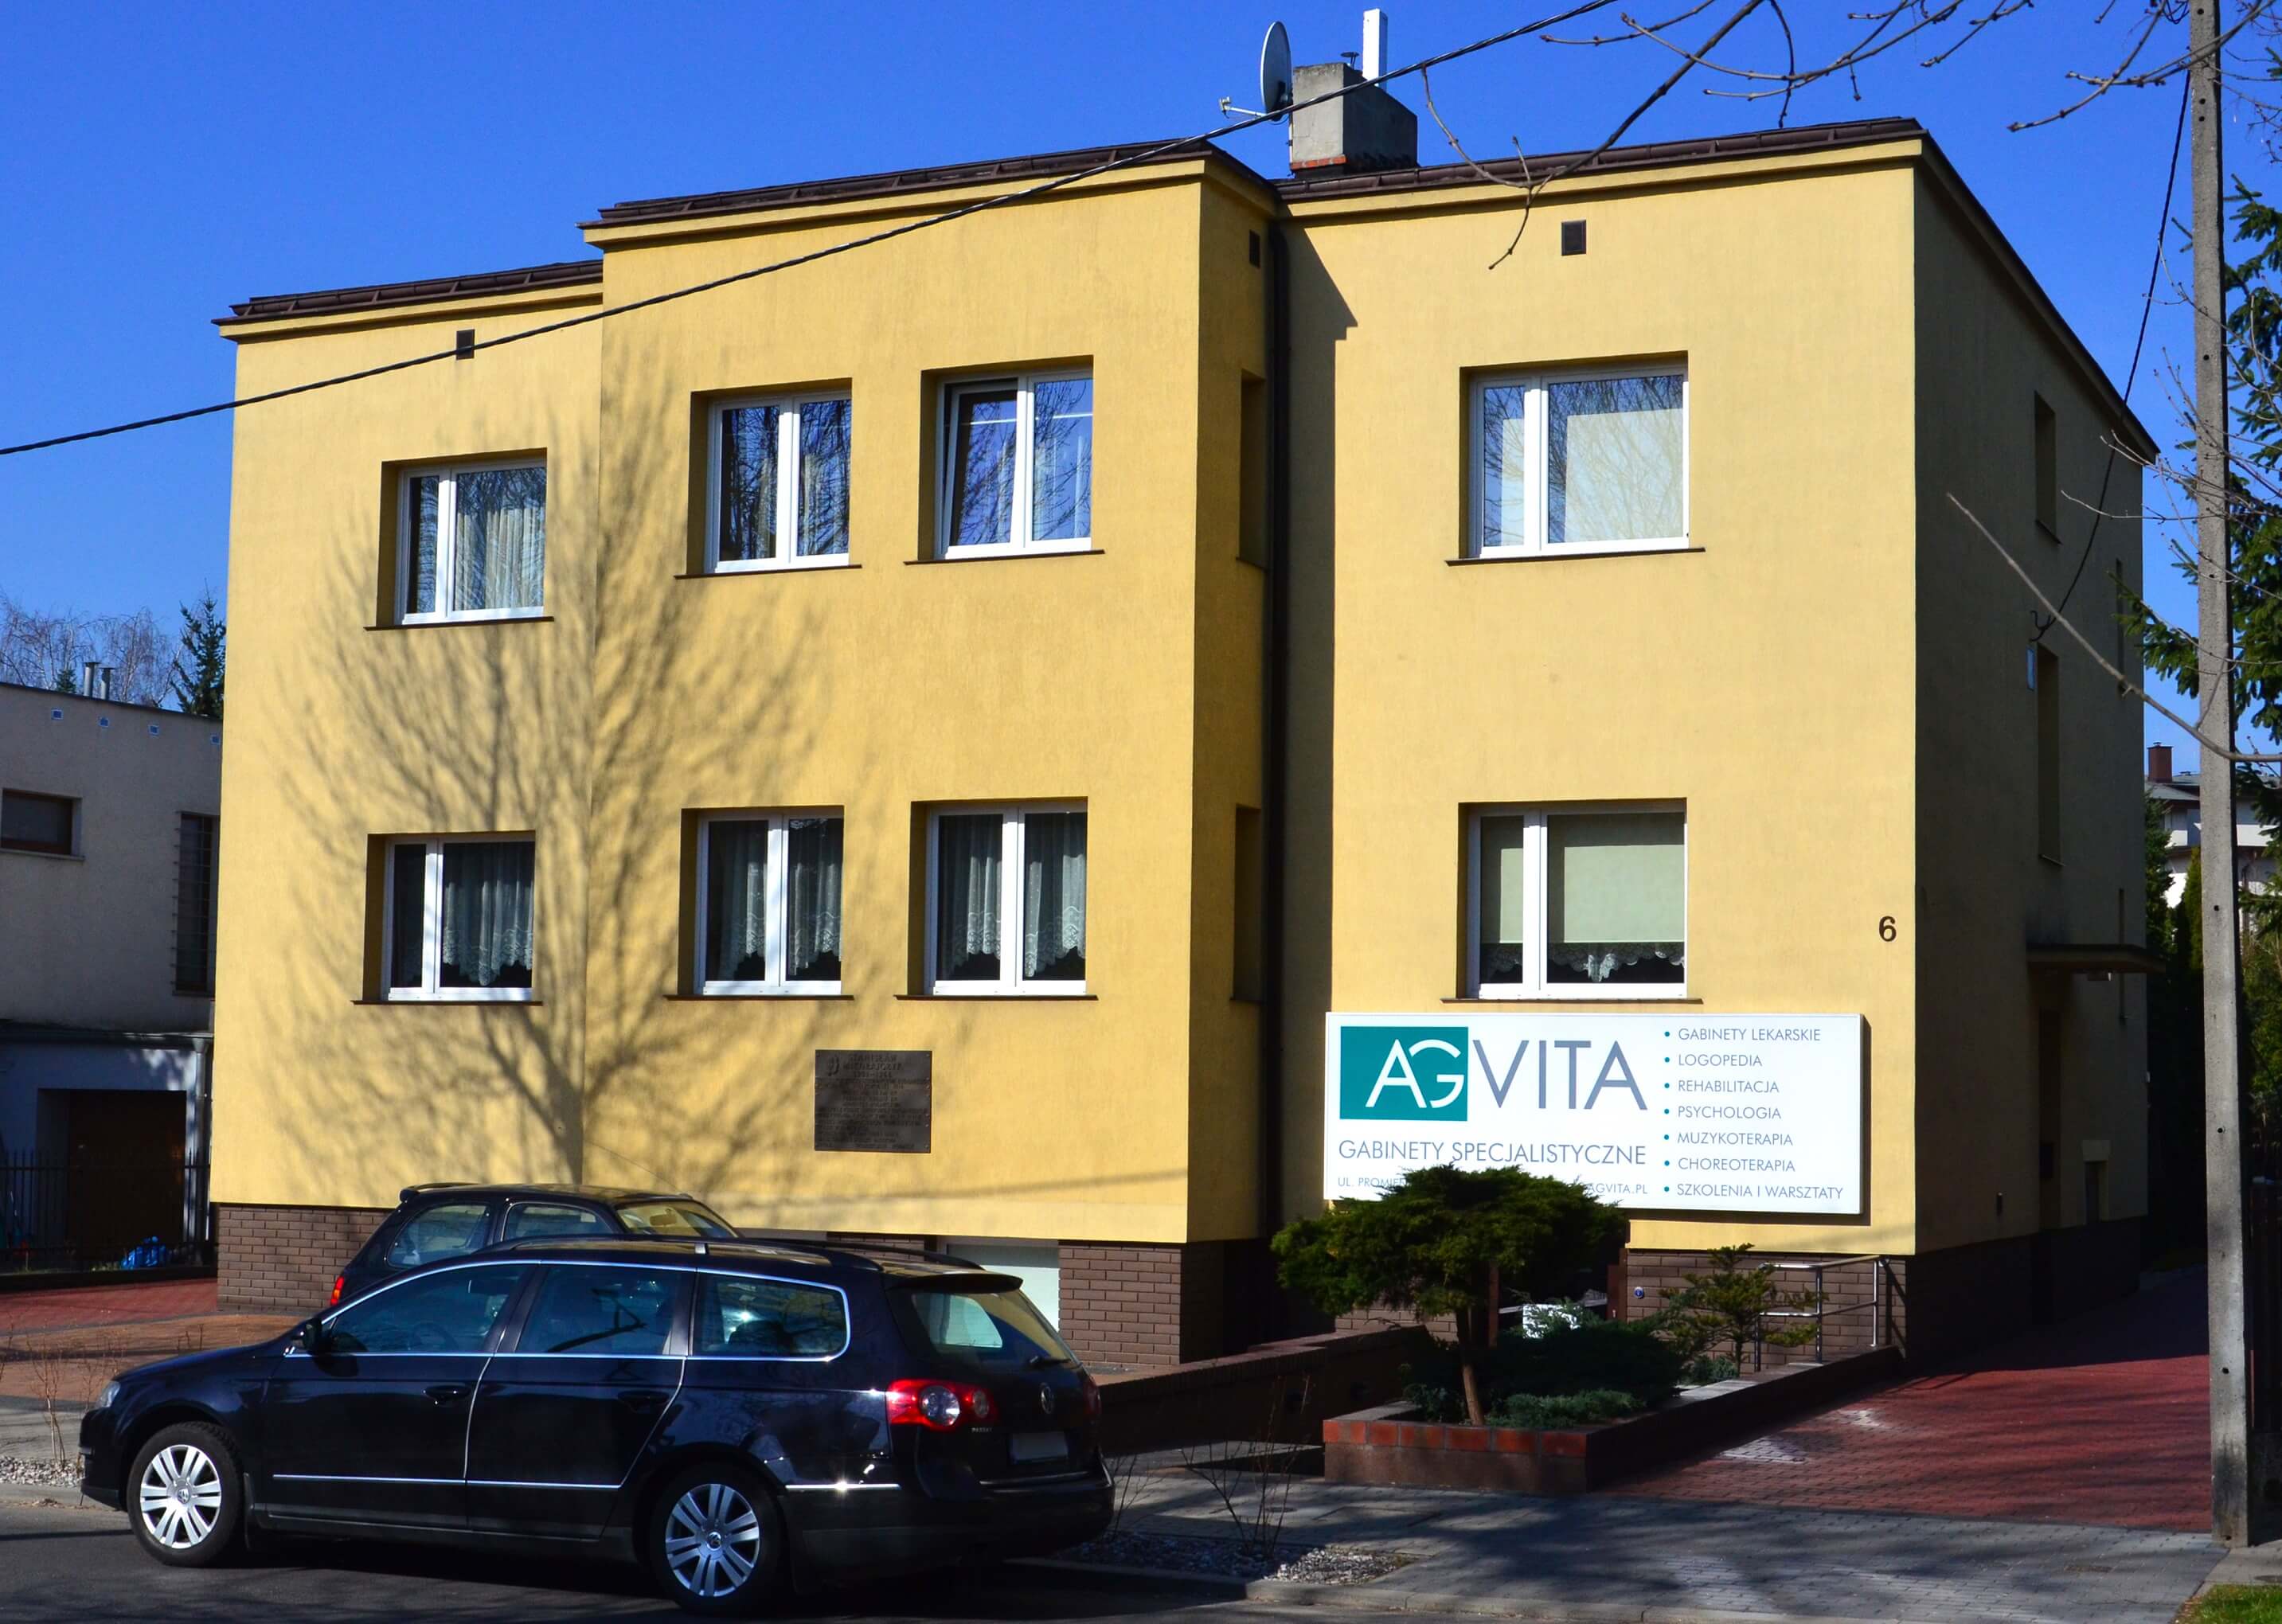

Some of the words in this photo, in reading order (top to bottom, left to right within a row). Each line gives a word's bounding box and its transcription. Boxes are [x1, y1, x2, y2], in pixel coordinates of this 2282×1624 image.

[1878, 915, 1897, 942] 6
[1678, 1028, 1747, 1040] GABINETY
[1751, 1028, 1821, 1041] LEKARSKIE
[1678, 1053, 1763, 1067] LOGOPEDIA
[1678, 1079, 1780, 1093] REHABILITACJA
[1678, 1105, 1782, 1119] PSYCHOLOGIA
[1677, 1131, 1794, 1146] MUZYKOTERAPIA
[1338, 1139, 1444, 1160] GABINETY
[1452, 1142, 1646, 1164] SPECJALISTYCZNE
[1678, 1157, 1796, 1172] CHOREOTERAPIA
[1587, 1182, 1648, 1194] AGVITA.PL
[1676, 1183, 1753, 1197] SZKOLENIA
[1756, 1185, 1761, 1198] I
[1764, 1185, 1844, 1200] WARSZTATY
